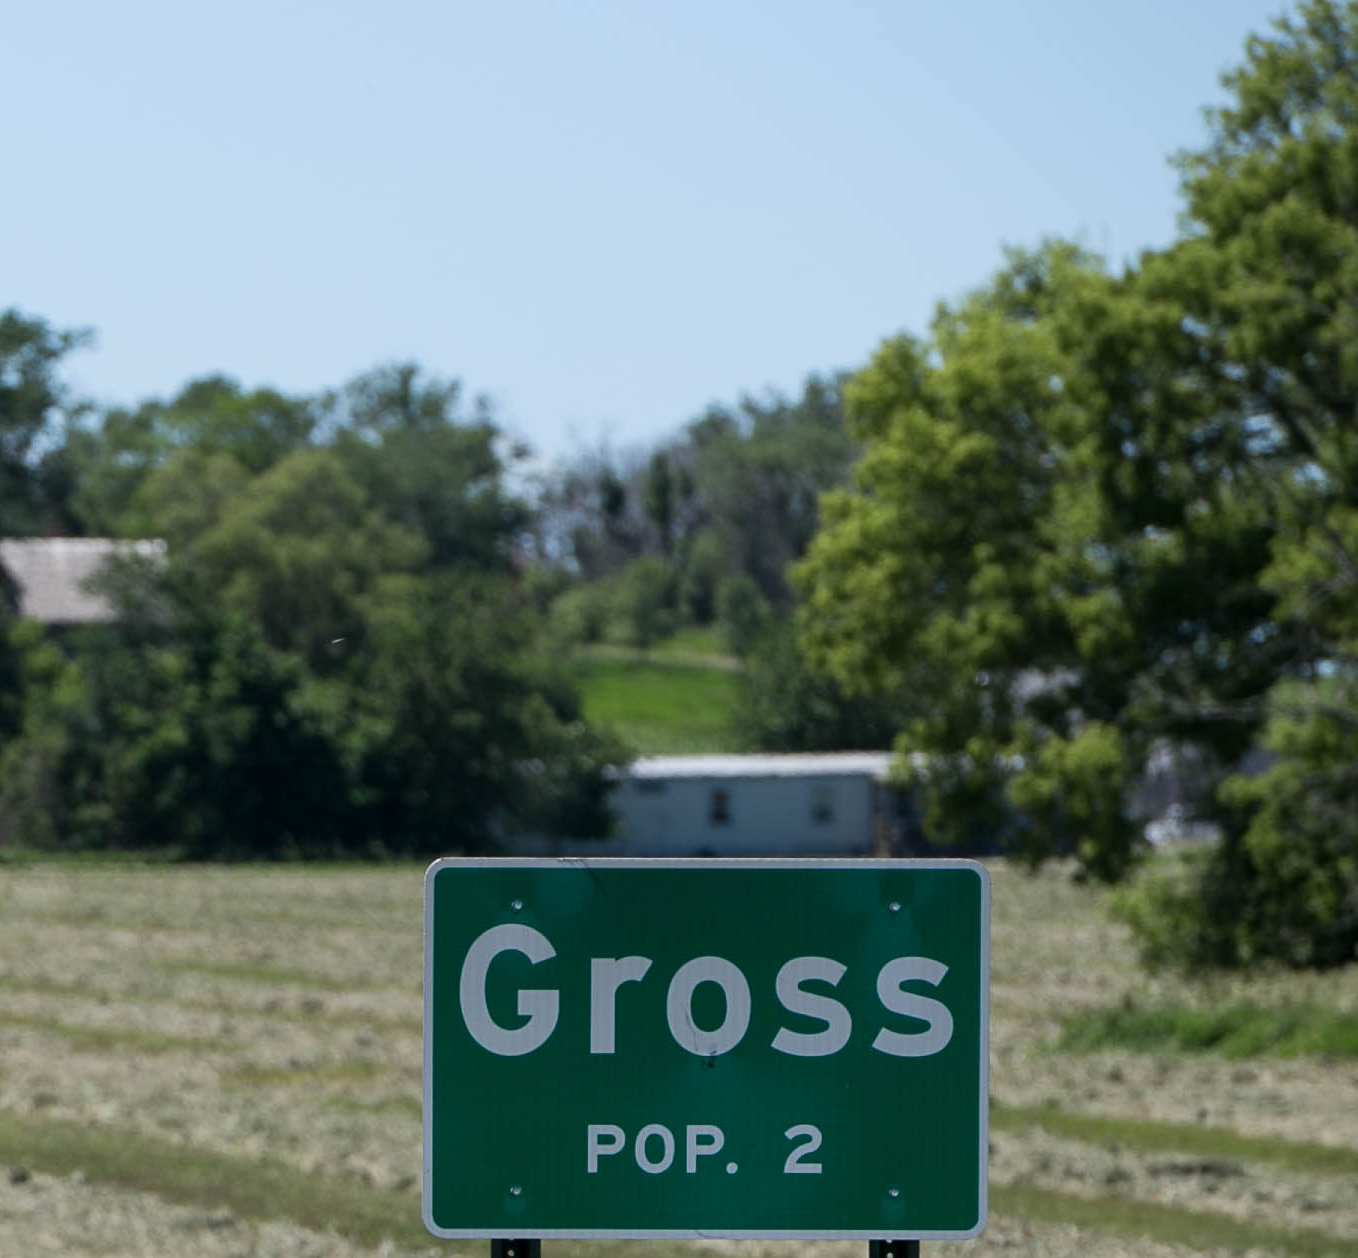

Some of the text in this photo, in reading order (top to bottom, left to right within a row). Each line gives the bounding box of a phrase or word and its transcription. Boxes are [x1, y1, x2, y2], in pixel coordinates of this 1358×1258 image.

[459, 923, 954, 1057] Gross
[587, 1124, 823, 1174] POP. 2
